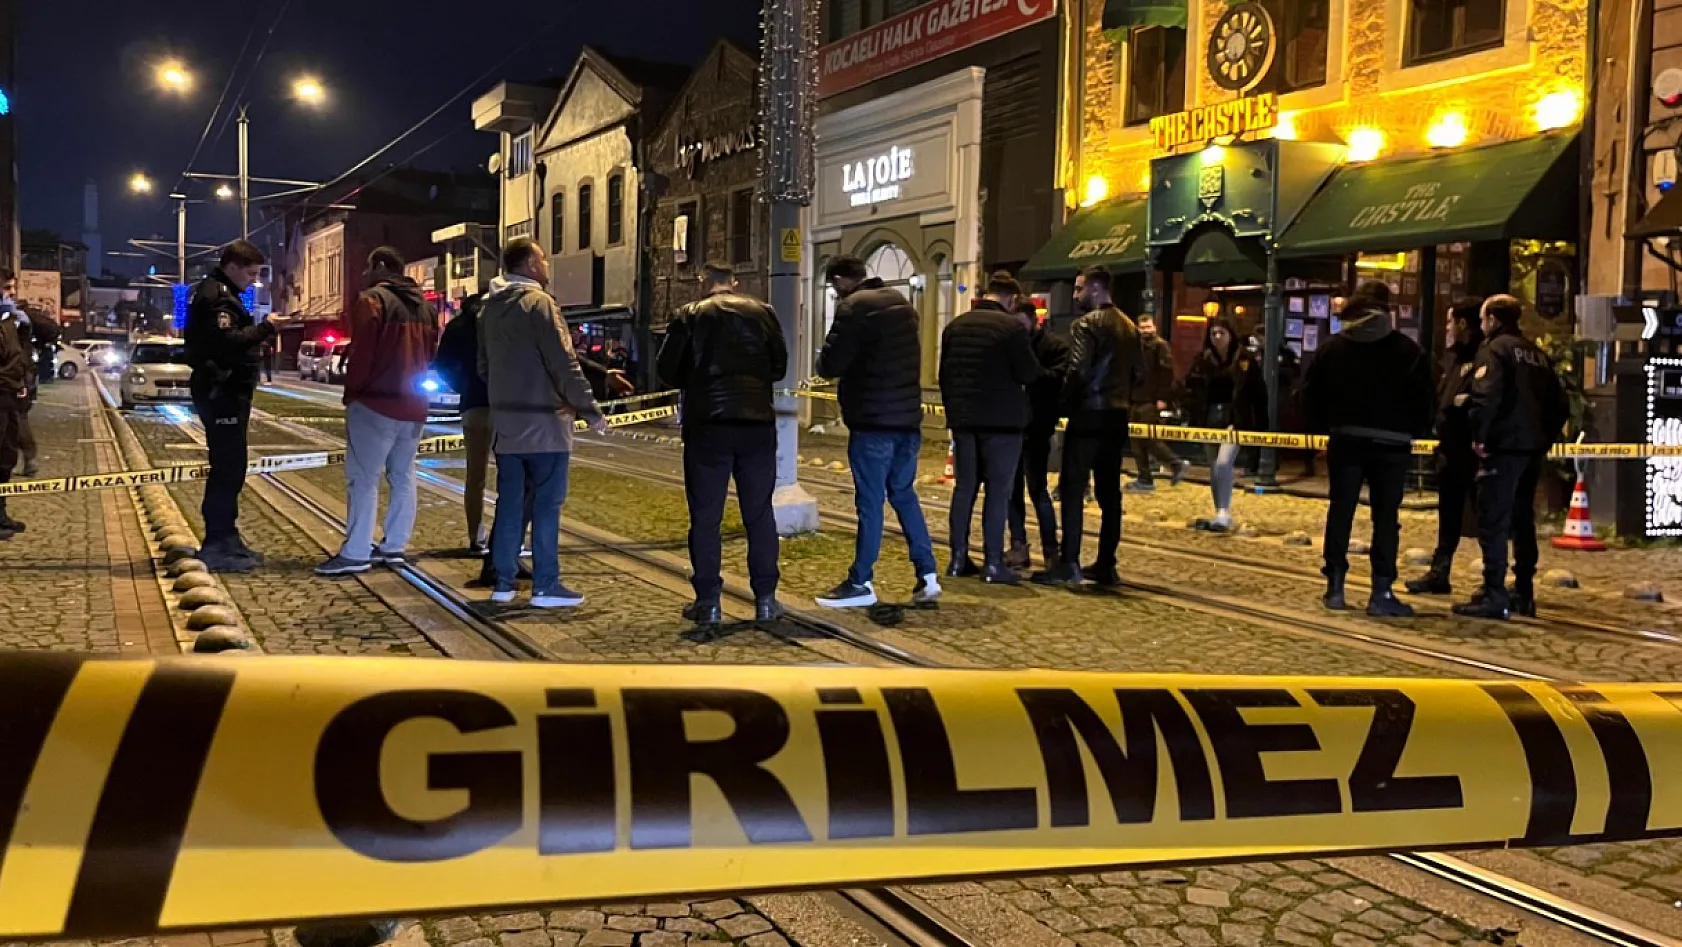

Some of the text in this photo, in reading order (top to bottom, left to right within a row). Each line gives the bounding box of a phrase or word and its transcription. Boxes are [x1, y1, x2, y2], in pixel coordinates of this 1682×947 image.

[881, 14, 924, 54] HALK
[926, 0, 1008, 35] GAZETE
[1149, 92, 1273, 150] THE CASTLE
[1404, 181, 1441, 200] THE
[1348, 195, 1461, 229] CASTLE
[606, 414, 638, 426] KAZA
[0, 482, 61, 494] RİLMEZ
[79, 471, 166, 488] KAZA YERİ
[313, 686, 1463, 863] GİRİLMEZ
